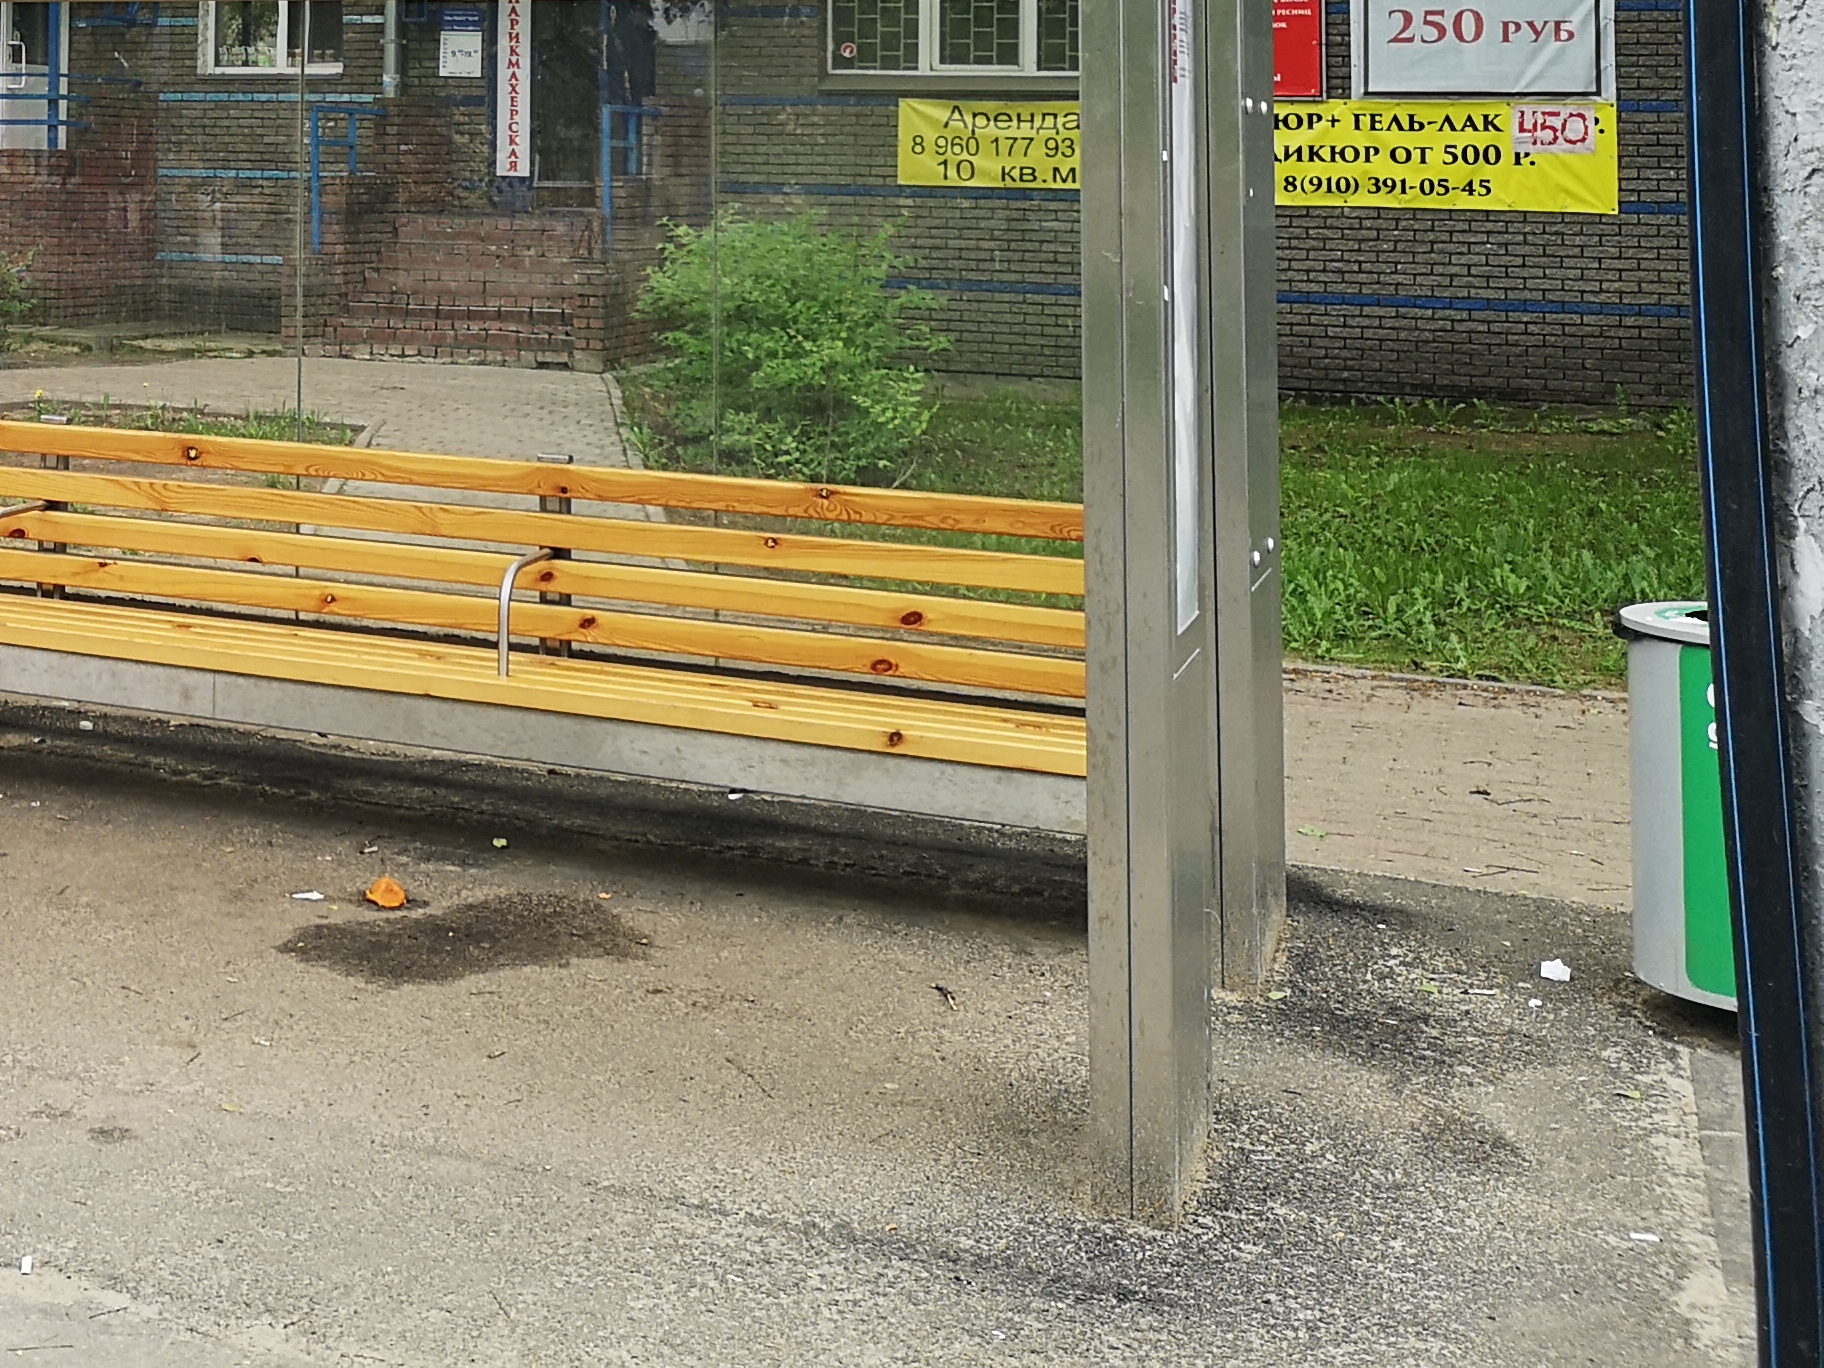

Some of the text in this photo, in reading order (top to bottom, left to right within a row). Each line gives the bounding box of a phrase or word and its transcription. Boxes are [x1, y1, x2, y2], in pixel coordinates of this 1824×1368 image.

[1386, 8, 1485, 44] 250
[943, 104, 1081, 136] Аренда
[1352, 112, 1504, 132] ГЕЛЬ-ЛАК
[1518, 110, 1589, 145] 450
[911, 134, 926, 155] 8
[934, 135, 980, 157] 960
[990, 136, 1035, 157] 177
[1389, 145, 1435, 165] ОТ
[1442, 144, 1503, 166] 500
[936, 158, 975, 182] 10
[1283, 175, 1493, 197] 8(910) 391-05-45
